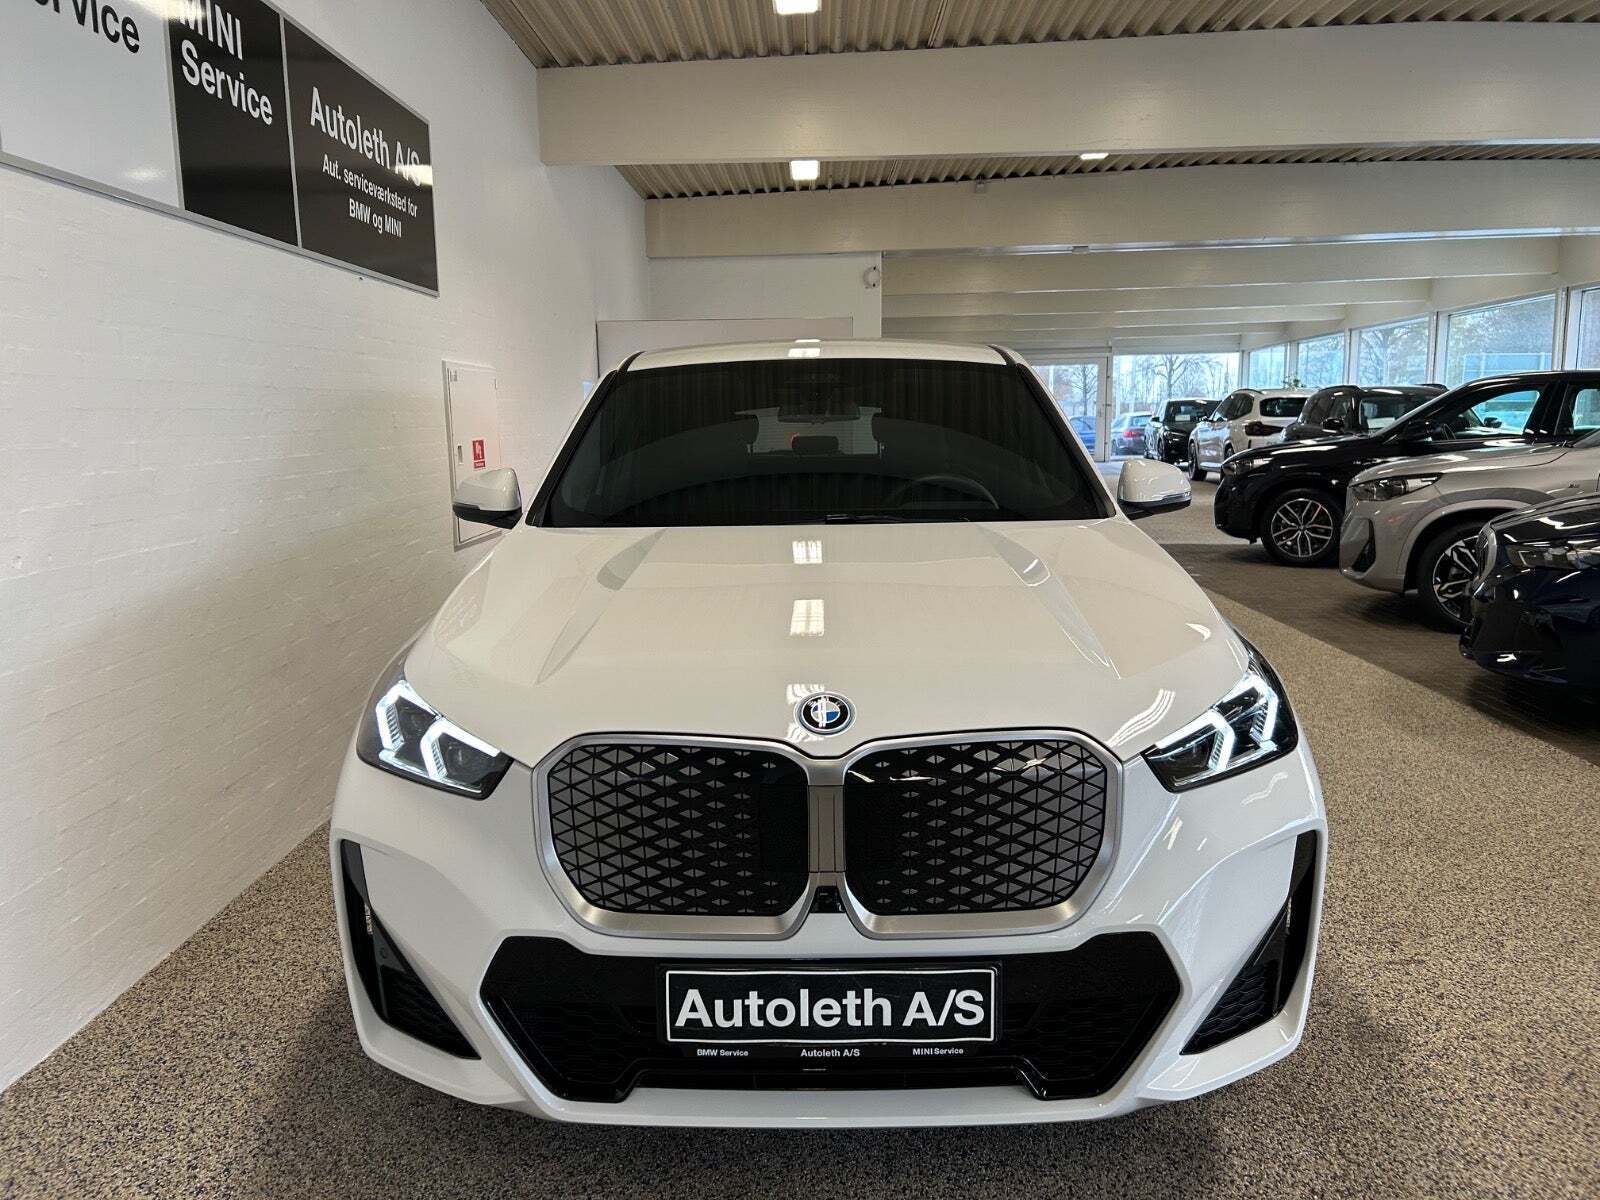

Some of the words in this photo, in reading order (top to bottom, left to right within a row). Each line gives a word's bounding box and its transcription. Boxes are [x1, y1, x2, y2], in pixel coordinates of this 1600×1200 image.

[181, 39, 273, 125] Service
[310, 86, 391, 170] Autoleth
[394, 141, 422, 187] A/S
[322, 153, 342, 180] Aut.
[343, 168, 407, 213] serviceværksted
[407, 197, 418, 218] for
[349, 198, 371, 225] BMW
[372, 213, 384, 235] og
[384, 214, 402, 238] MINI
[674, 988, 893, 1028] Autoleth
[901, 989, 985, 1028] A/S
[696, 1049, 718, 1057] BMW
[719, 1049, 749, 1057] Service
[800, 1048, 841, 1057] Autoleth
[843, 1048, 861, 1057] A/S
[912, 1048, 933, 1056] MINI
[934, 1047, 964, 1055] Service
